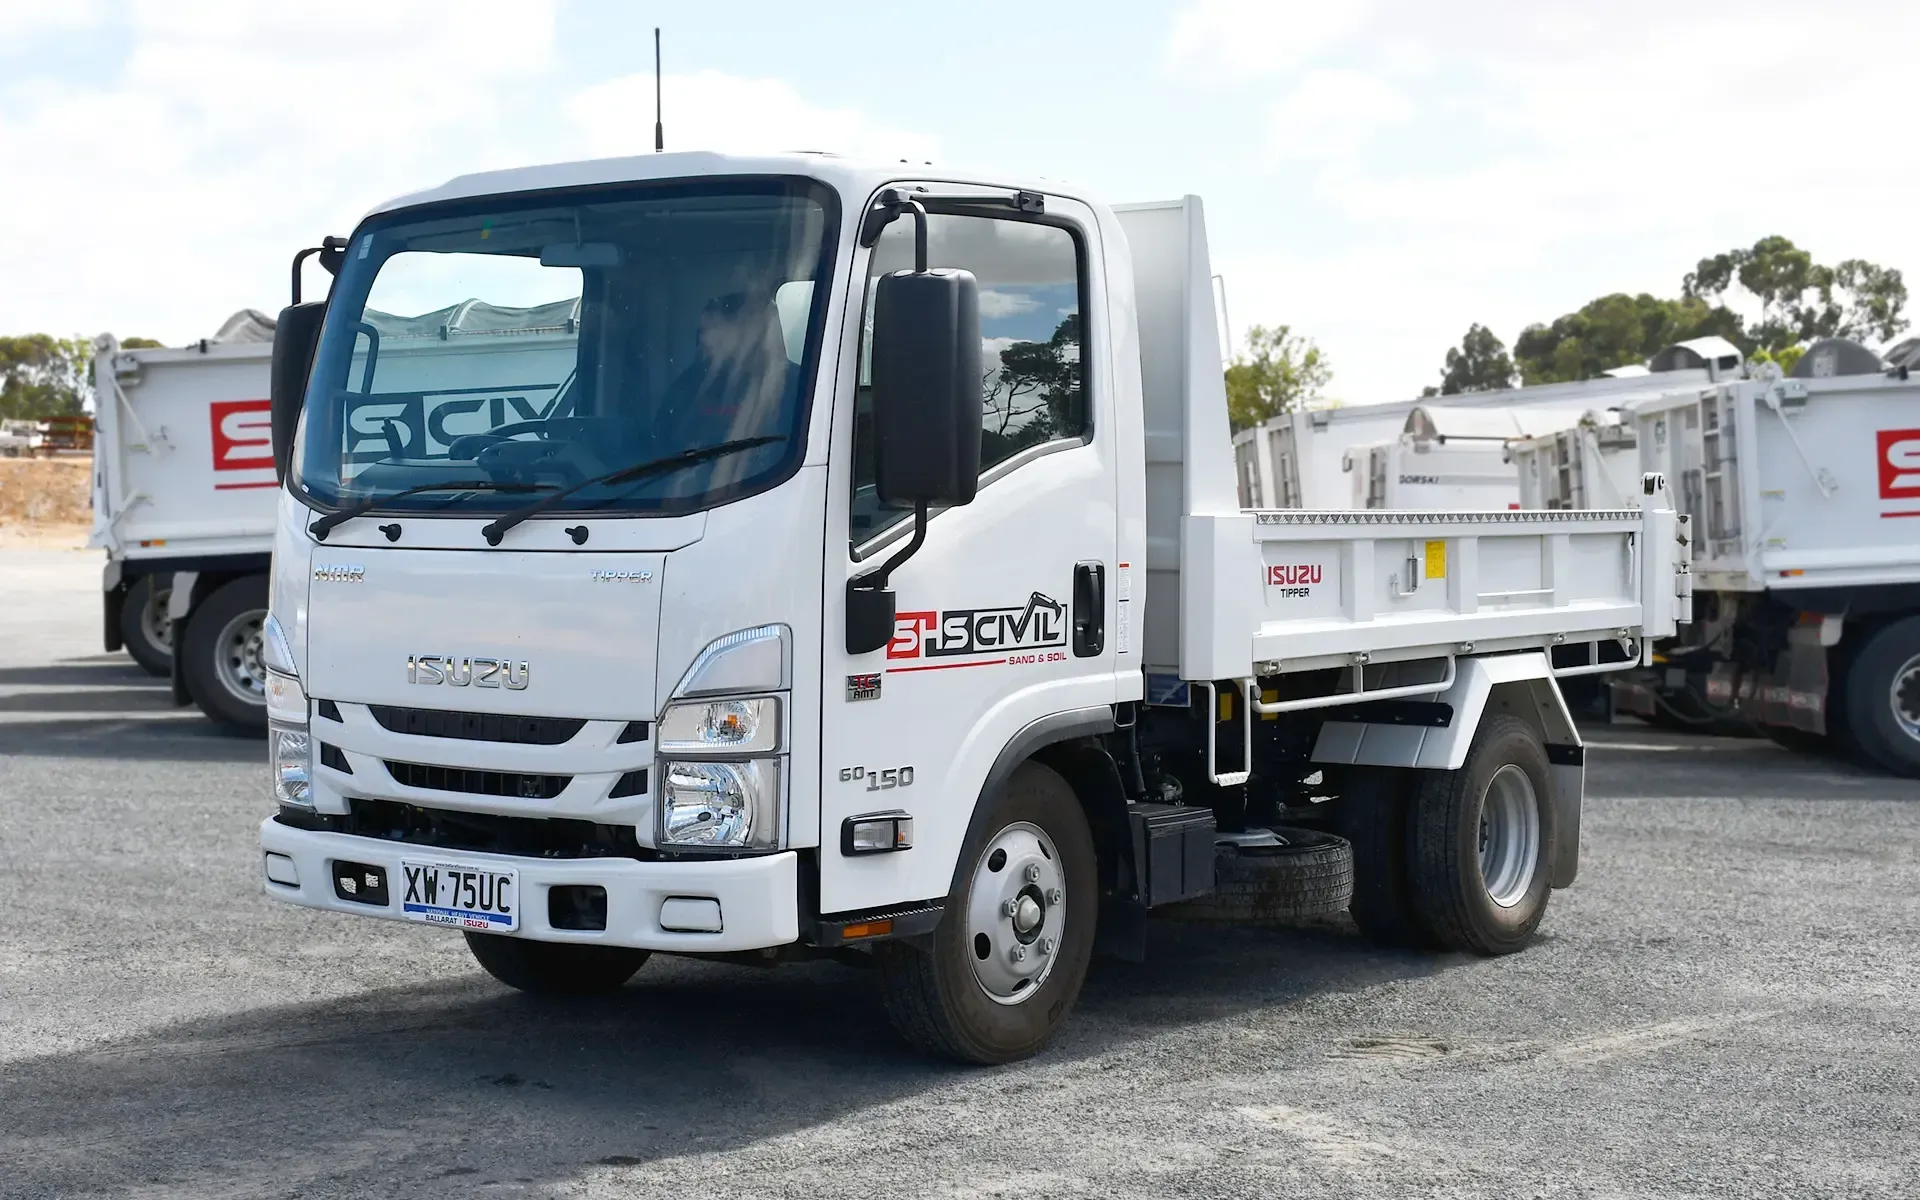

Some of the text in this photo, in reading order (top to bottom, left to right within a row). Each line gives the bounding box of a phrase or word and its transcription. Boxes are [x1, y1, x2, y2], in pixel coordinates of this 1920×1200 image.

[314, 563, 365, 583] NMR
[590, 569, 653, 583] TIPPER
[1267, 564, 1322, 585] ISUZU
[1280, 587, 1310, 598] TIPPER
[1008, 652, 1067, 665] SAND & SOIL
[407, 653, 530, 691] ISUZU
[853, 690, 875, 699] AMT
[866, 766, 914, 792] 150
[425, 914, 489, 929] BALLARAT ISUZU
